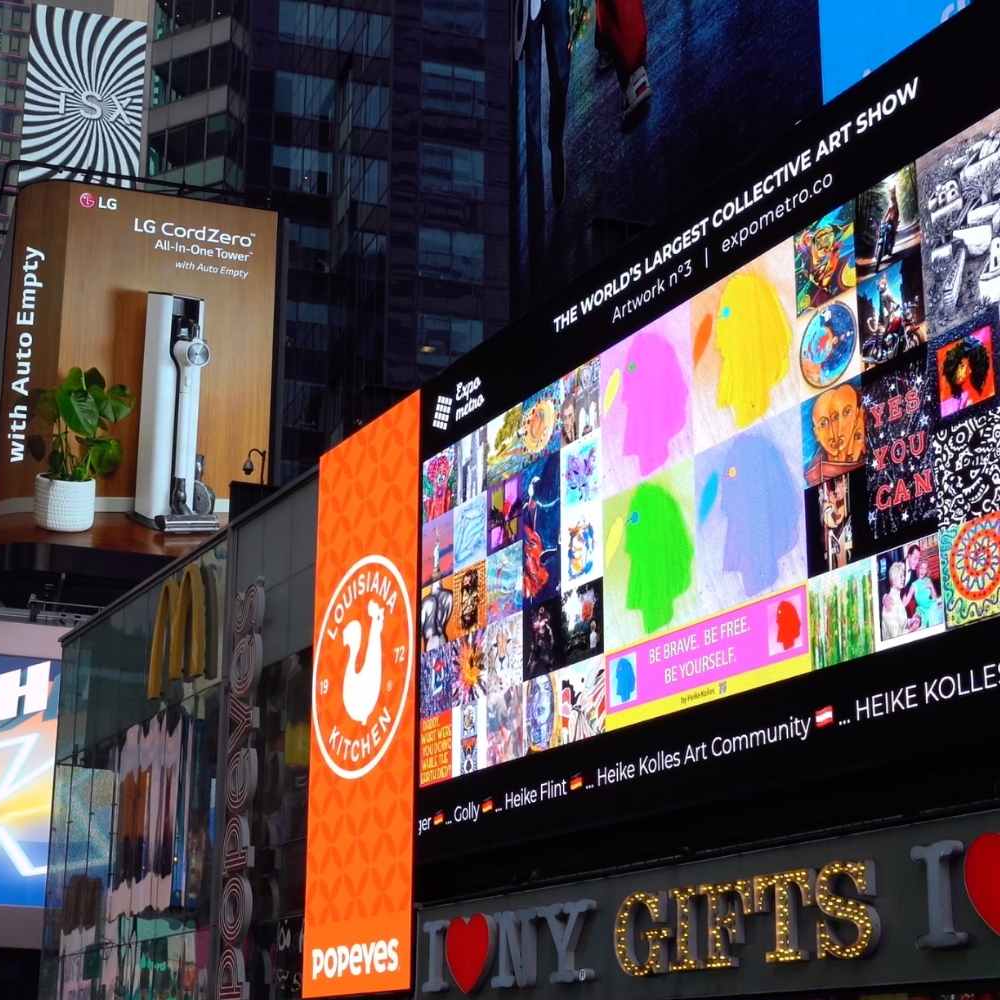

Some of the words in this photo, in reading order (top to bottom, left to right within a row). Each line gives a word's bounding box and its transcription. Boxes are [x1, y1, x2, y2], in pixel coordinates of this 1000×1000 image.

[98, 197, 117, 210] LG
[553, 304, 578, 333] THE
[580, 262, 642, 316] WORLD'S
[645, 218, 709, 275] LARGEST
[712, 152, 812, 227] COLLECTIVE
[815, 123, 852, 162] ART
[856, 77, 919, 135] SHOW
[134, 218, 156, 234] LG
[155, 240, 214, 257] All-In-One
[611, 282, 666, 325] Artwork
[721, 172, 834, 253] expometro.co
[17, 246, 45, 325] Empty
[175, 260, 195, 271] with
[197, 262, 218, 273] Auto
[219, 266, 249, 279] Empty
[12, 332, 34, 396] Auto
[455, 394, 485, 421] metro
[456, 377, 482, 401] Expo
[871, 389, 921, 427] YES
[10, 404, 27, 463] with
[873, 431, 927, 470] YOU
[875, 470, 933, 511] CAN
[327, 571, 399, 640] LOUISIANA
[649, 647, 661, 665] BE
[704, 627, 718, 646] BE
[664, 667, 677, 684] BE
[679, 647, 737, 680] YOURSELF.
[319, 678, 330, 696] 19
[329, 707, 392, 762] KITCHEN
[454, 801, 480, 823] Golly
[505, 787, 538, 810] Heike
[540, 778, 567, 801] Flint
[597, 762, 636, 788] Heike
[639, 752, 681, 777] Kolles
[684, 742, 708, 765] Art
[711, 715, 812, 757] Community
[856, 684, 918, 721] HEIKE
[613, 860, 880, 977] GIFTS
[422, 919, 450, 993] I
